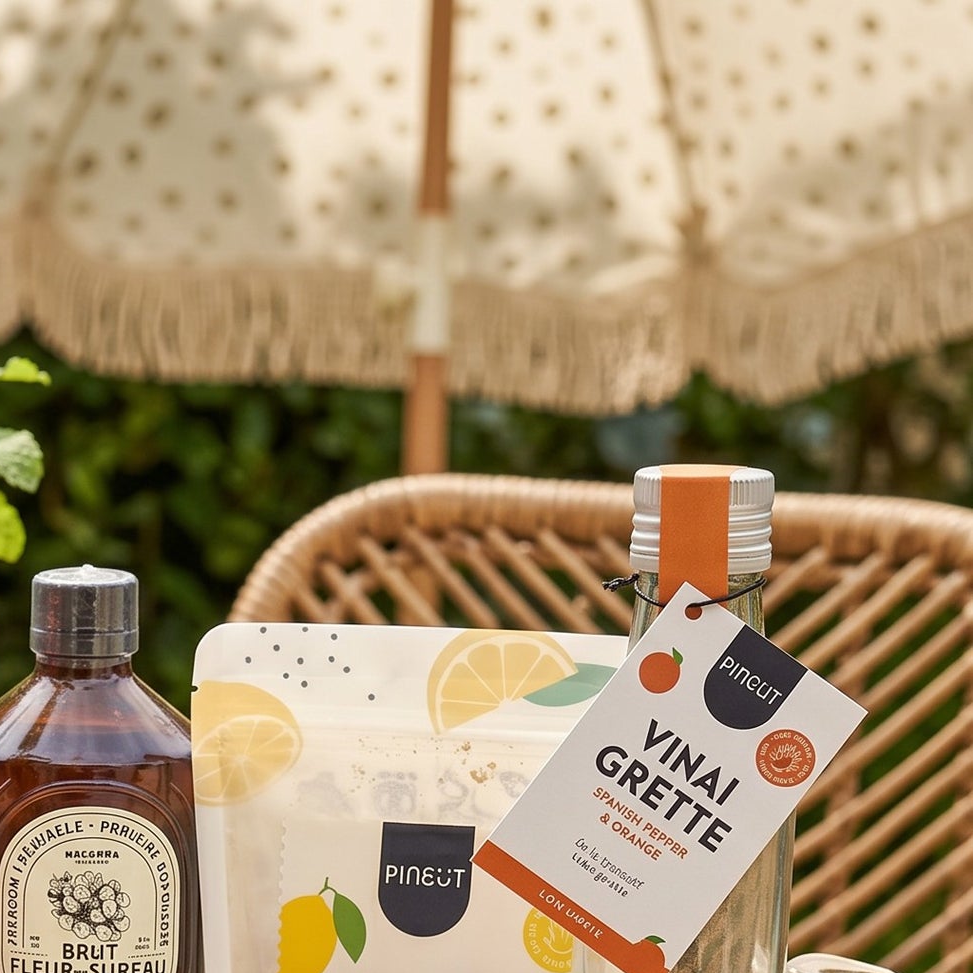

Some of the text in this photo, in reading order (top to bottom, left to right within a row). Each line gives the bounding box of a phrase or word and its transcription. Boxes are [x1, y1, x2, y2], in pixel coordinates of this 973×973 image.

[595, 745, 733, 854] GRETTE
[642, 718, 741, 807] VINAI
[592, 786, 689, 860] SPANISH PEPPER
[599, 812, 663, 861] & ORANGE
